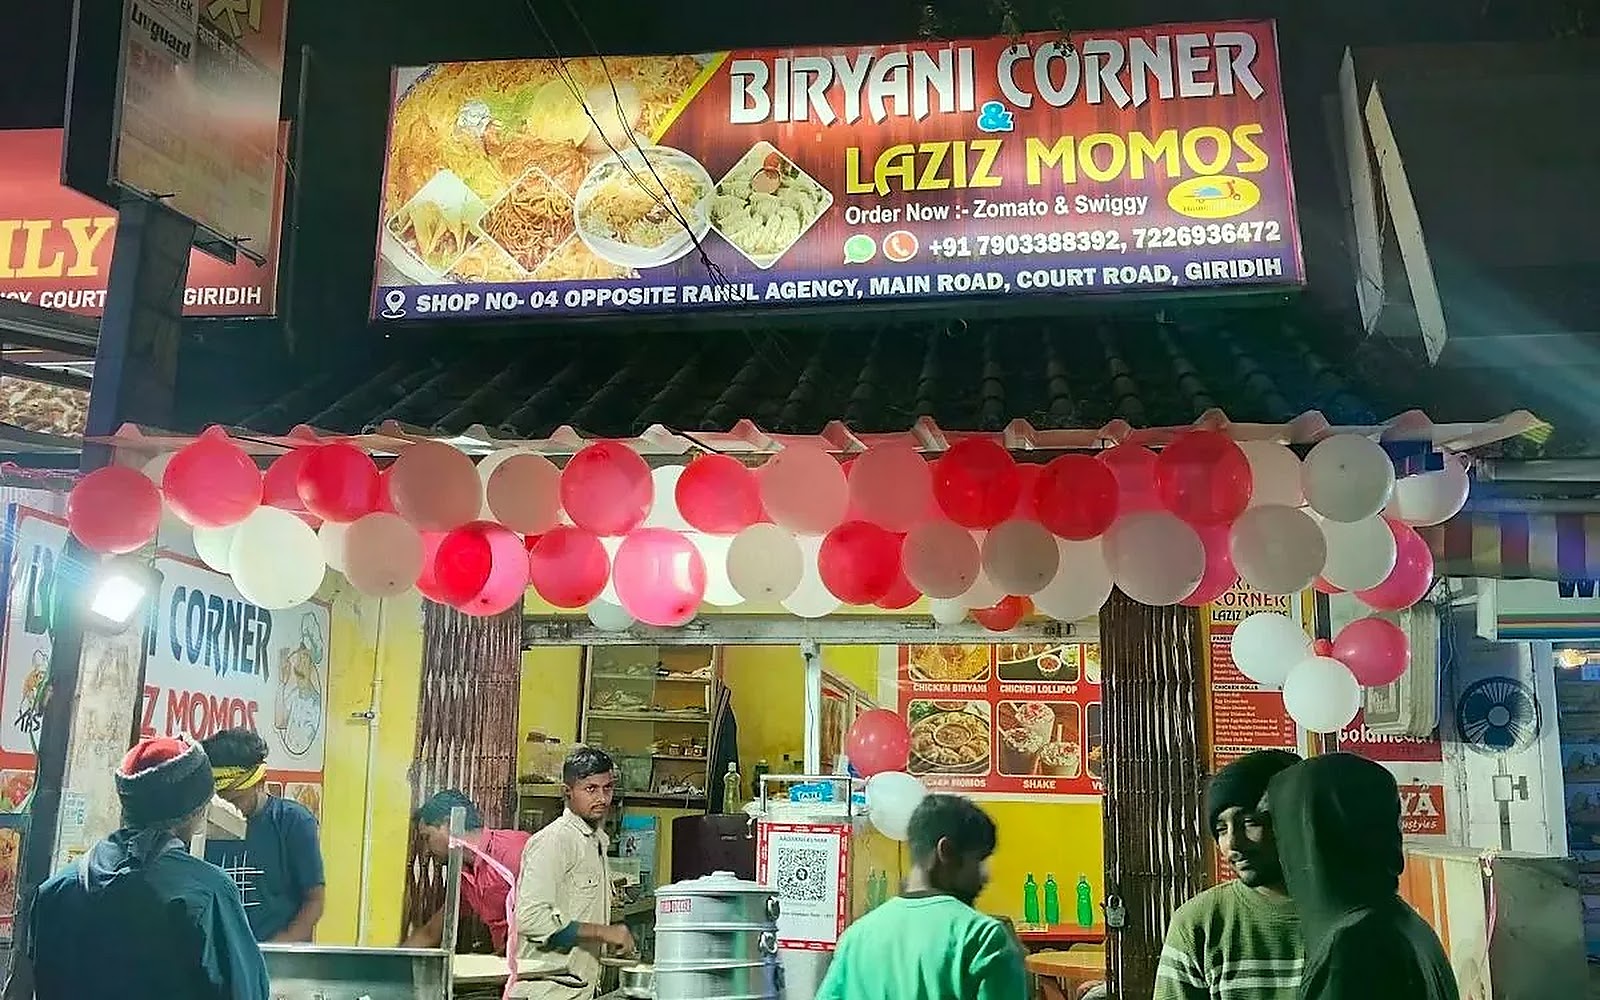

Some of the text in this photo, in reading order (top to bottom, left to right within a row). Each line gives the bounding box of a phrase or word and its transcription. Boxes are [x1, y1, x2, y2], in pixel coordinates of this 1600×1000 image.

[730, 31, 1266, 127] BIRYANI CORNER
[977, 101, 1015, 133] &
[845, 123, 1270, 197] LAZIZ MOMOS
[844, 205, 901, 225] Order
[906, 204, 948, 222] Now
[972, 199, 1050, 219] Zomato
[1055, 197, 1071, 215] &
[1074, 194, 1148, 217] Swiggy
[929, 221, 1281, 256] +91 7903388392, 7226936472
[40, 289, 107, 309] COURT
[183, 286, 261, 306] GIRIDIH
[416, 293, 479, 312] SHOP
[485, 290, 525, 310] NO-
[530, 290, 559, 308] 04
[565, 286, 676, 307] OPPOSITE
[765, 279, 863, 300] AGENCY,
[869, 276, 931, 296] MAIN
[936, 272, 1011, 293] ROAD,
[1017, 267, 1097, 289] COURT
[1103, 263, 1179, 286] ROAD,
[1184, 258, 1283, 281] GIRIDIH
[1212, 609, 1241, 621] LAZIZ
[170, 586, 273, 683] CORNER
[913, 683, 988, 693] CHICKEN BIRYANI
[1000, 684, 1078, 695] CHICKEN LOLLIPOP
[1023, 780, 1056, 790] SHAKE
